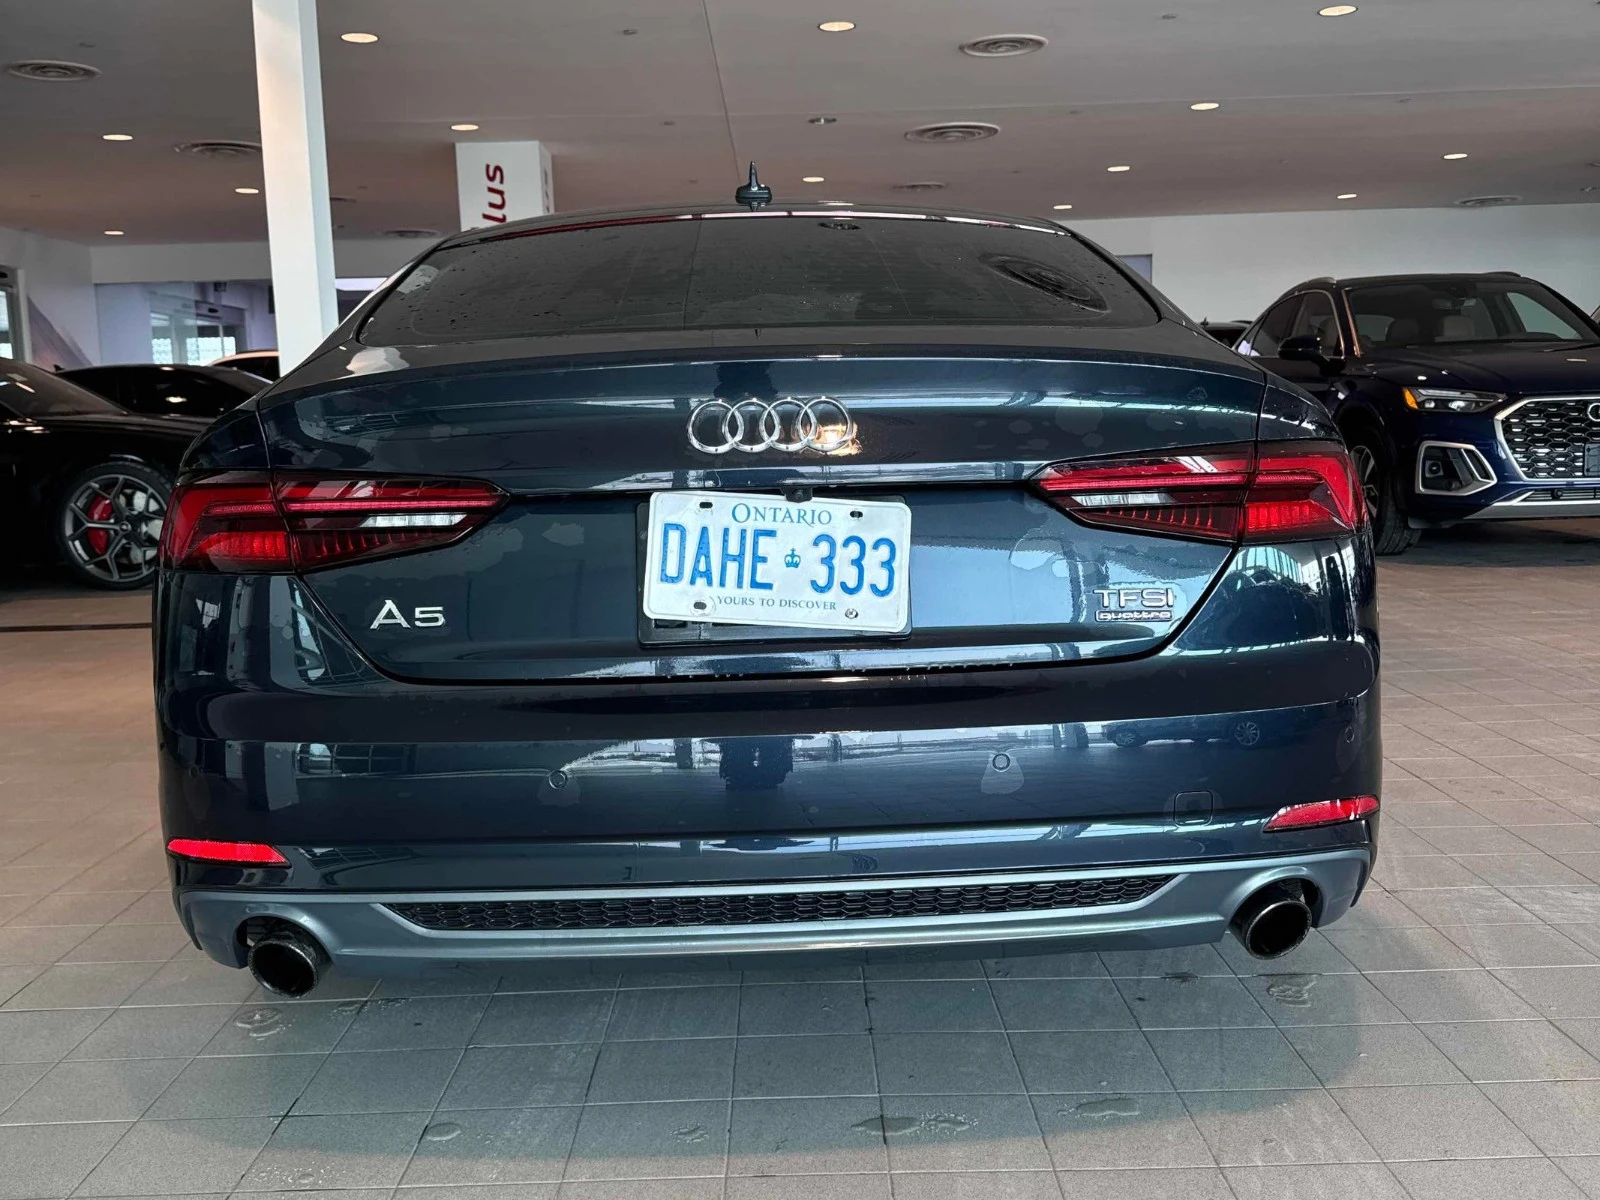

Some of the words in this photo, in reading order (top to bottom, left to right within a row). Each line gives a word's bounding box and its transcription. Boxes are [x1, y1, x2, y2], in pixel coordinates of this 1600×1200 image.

[731, 503, 832, 528] ONTARIO
[660, 523, 777, 591] DAHE
[810, 534, 896, 597] 333
[717, 595, 755, 607] YOURS
[760, 597, 775, 607] TO
[779, 598, 836, 610] DISCOVER
[1093, 588, 1174, 608] TFSI
[369, 599, 446, 630] A5
[1099, 611, 1171, 620] quattro
